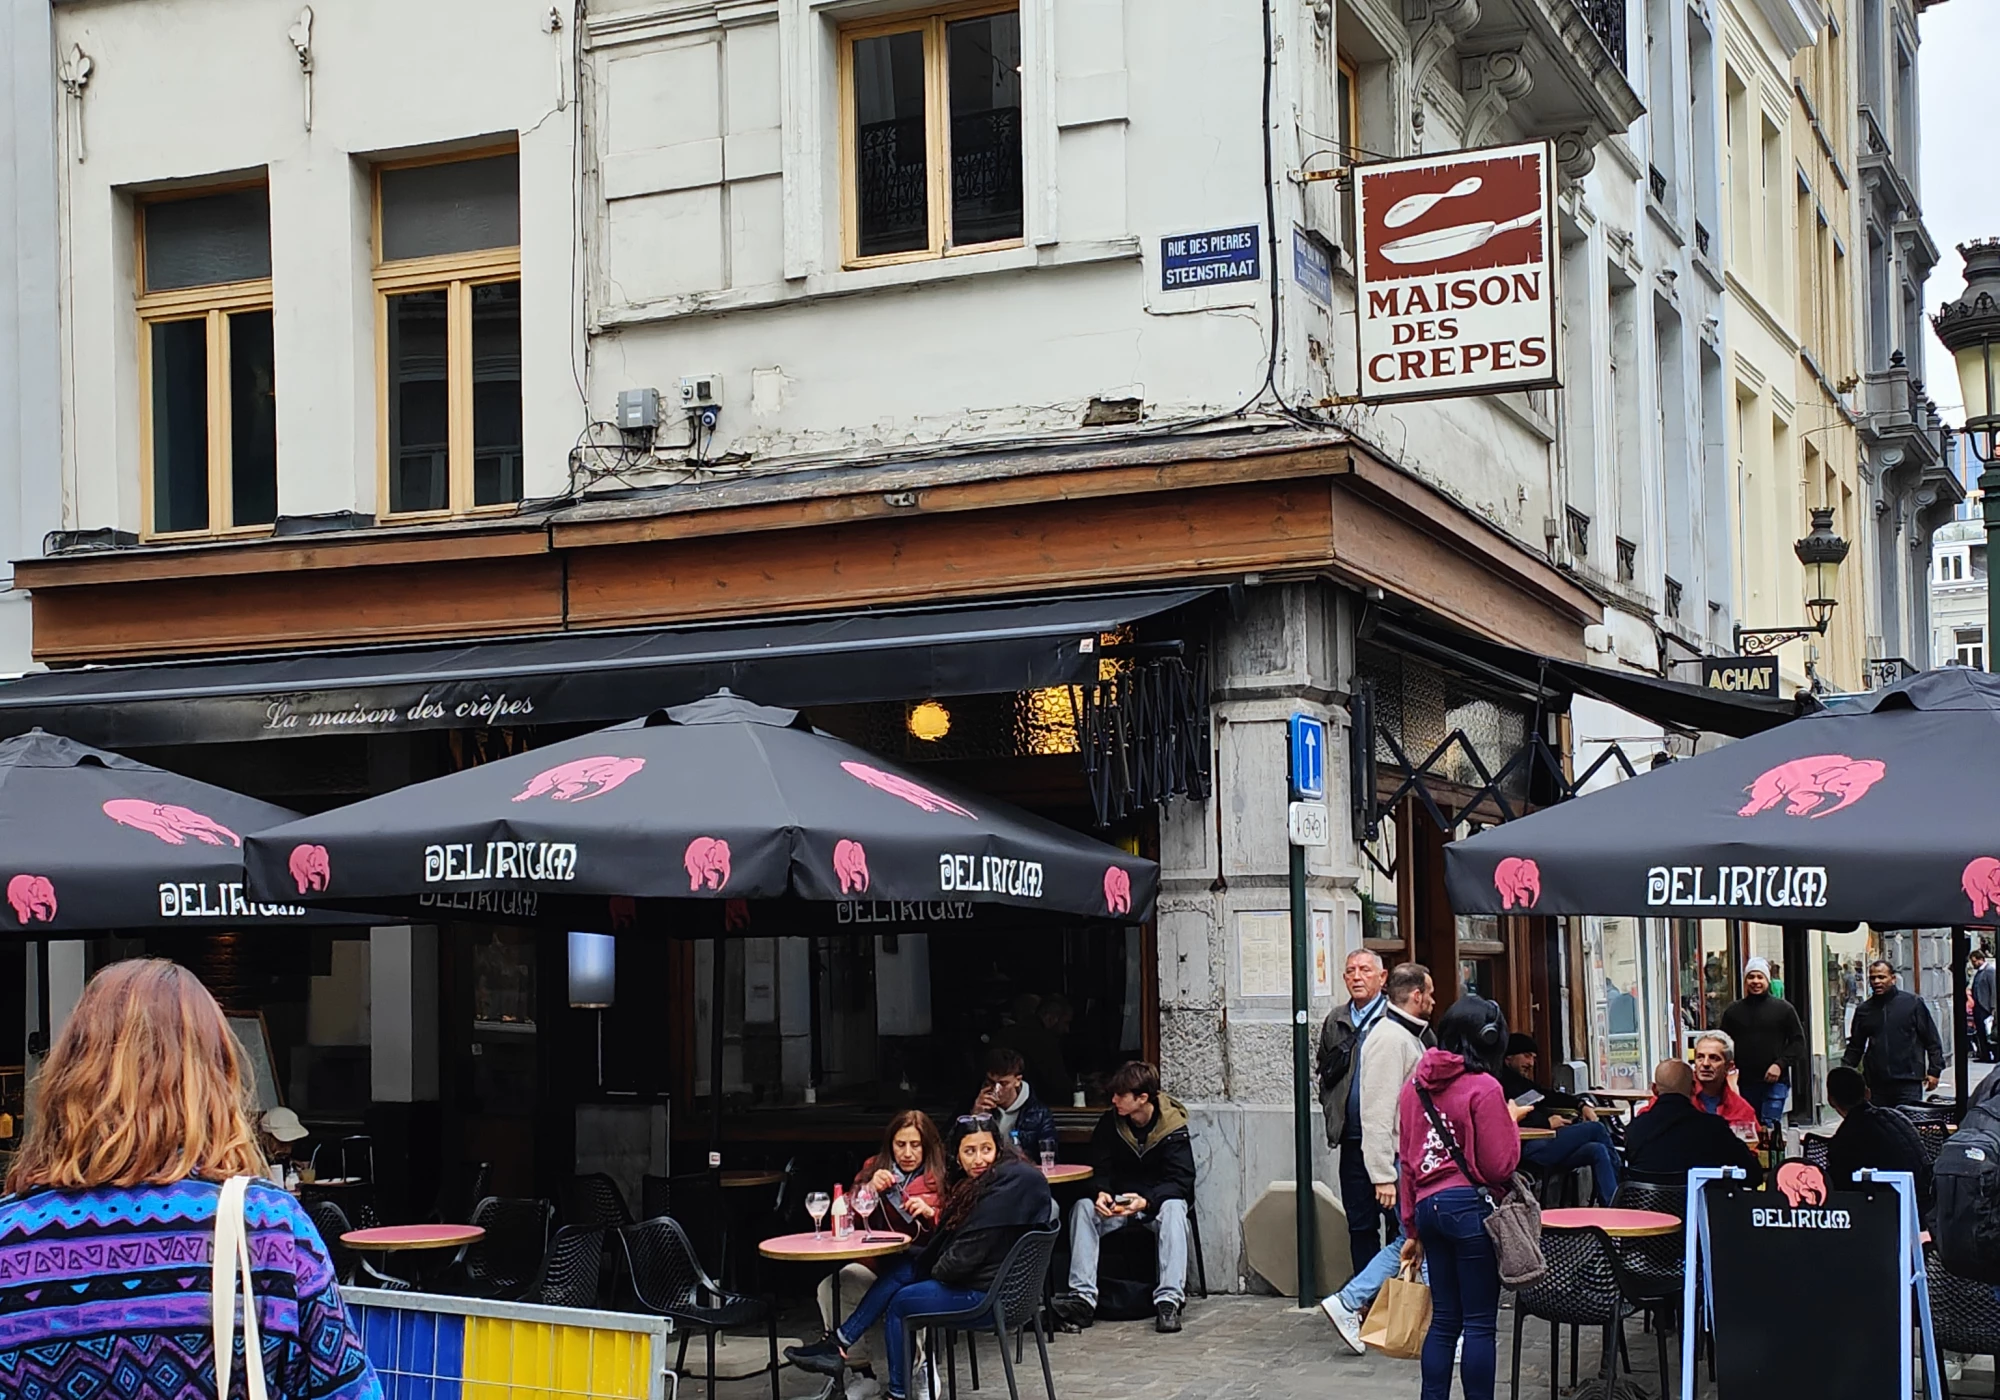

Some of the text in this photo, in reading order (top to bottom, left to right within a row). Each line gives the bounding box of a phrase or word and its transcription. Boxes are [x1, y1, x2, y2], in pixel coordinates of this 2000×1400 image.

[1168, 233, 1252, 257] RUE DES PIERRES
[1166, 260, 1255, 284] STEENSTRAAT
[1367, 271, 1542, 319] MAISON
[1392, 318, 1459, 345] DES
[1368, 336, 1546, 382] CREPES
[1709, 667, 1773, 691] ACHAT
[264, 694, 535, 729] La maison des crêpes
[425, 841, 577, 882] DELIRIUM
[939, 854, 1043, 898] DELIRIUM
[1648, 866, 1828, 907] DELIRIUM
[1752, 1208, 1851, 1229] DELIRIUM
